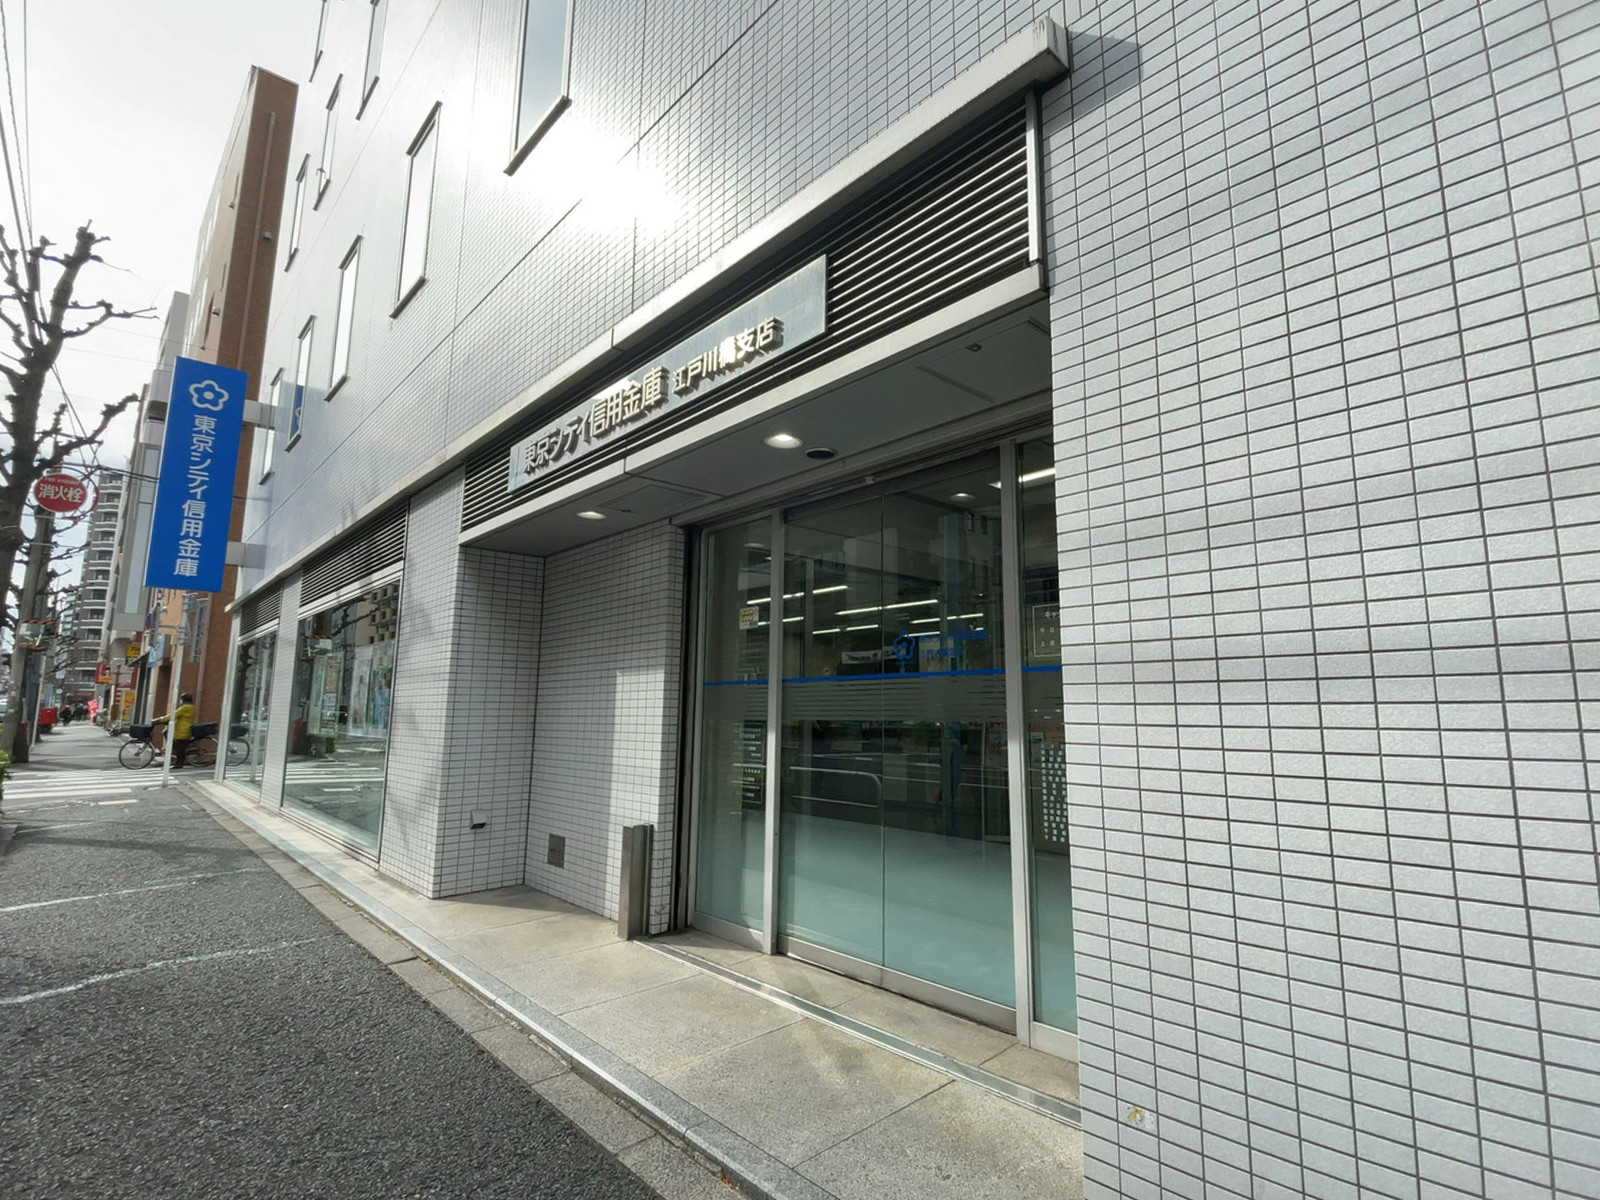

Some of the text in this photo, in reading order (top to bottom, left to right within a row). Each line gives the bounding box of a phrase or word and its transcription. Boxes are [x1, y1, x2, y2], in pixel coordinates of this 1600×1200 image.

[525, 366, 667, 472] 東京シティ信用金庫
[38, 483, 84, 503] 消火栓
[173, 414, 217, 577] 東京シティ信用金庫
